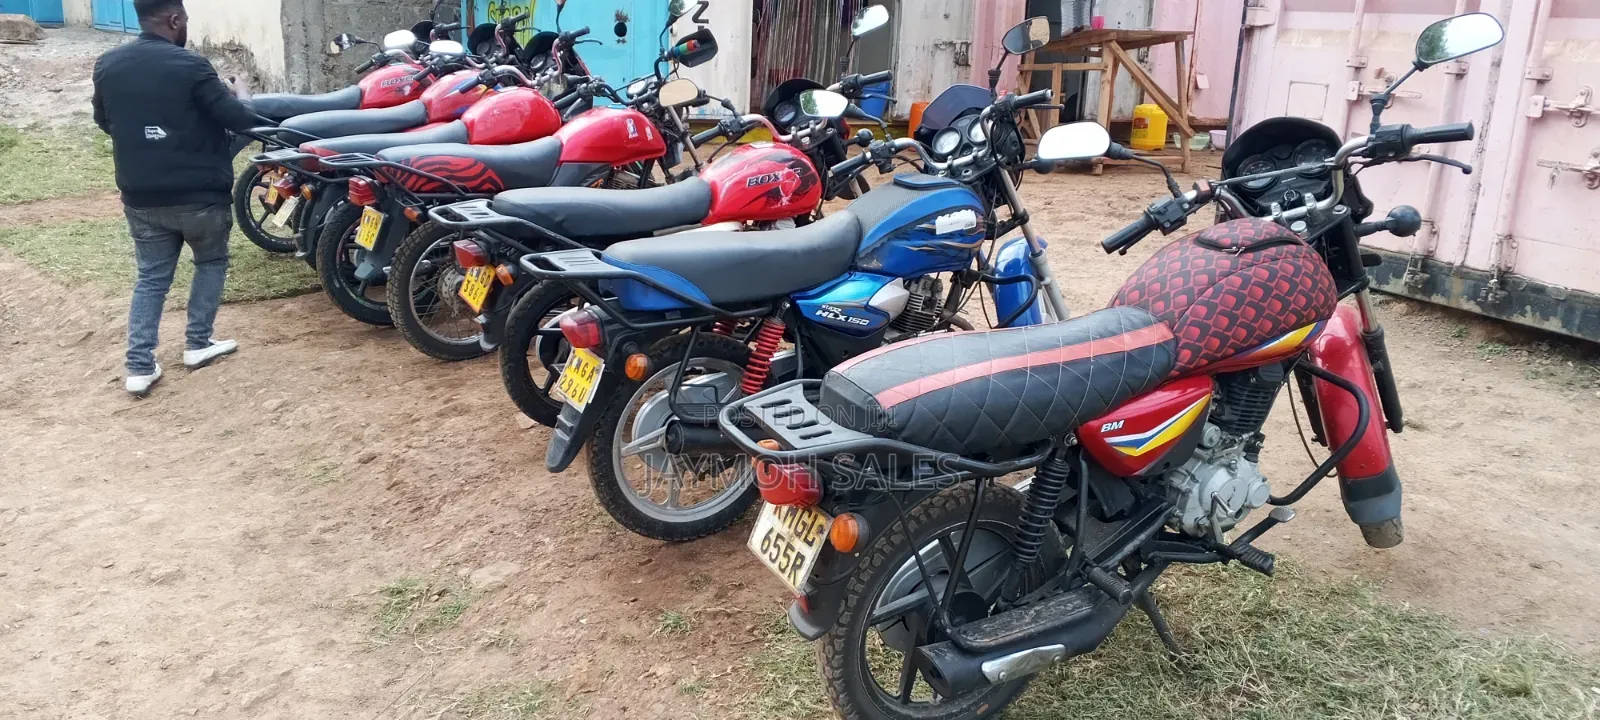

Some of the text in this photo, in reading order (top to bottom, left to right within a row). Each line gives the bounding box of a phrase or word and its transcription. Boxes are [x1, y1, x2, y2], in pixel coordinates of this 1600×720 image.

[559, 374, 588, 403] 296U
[1101, 419, 1125, 433] BM
[760, 527, 806, 586] 655R
